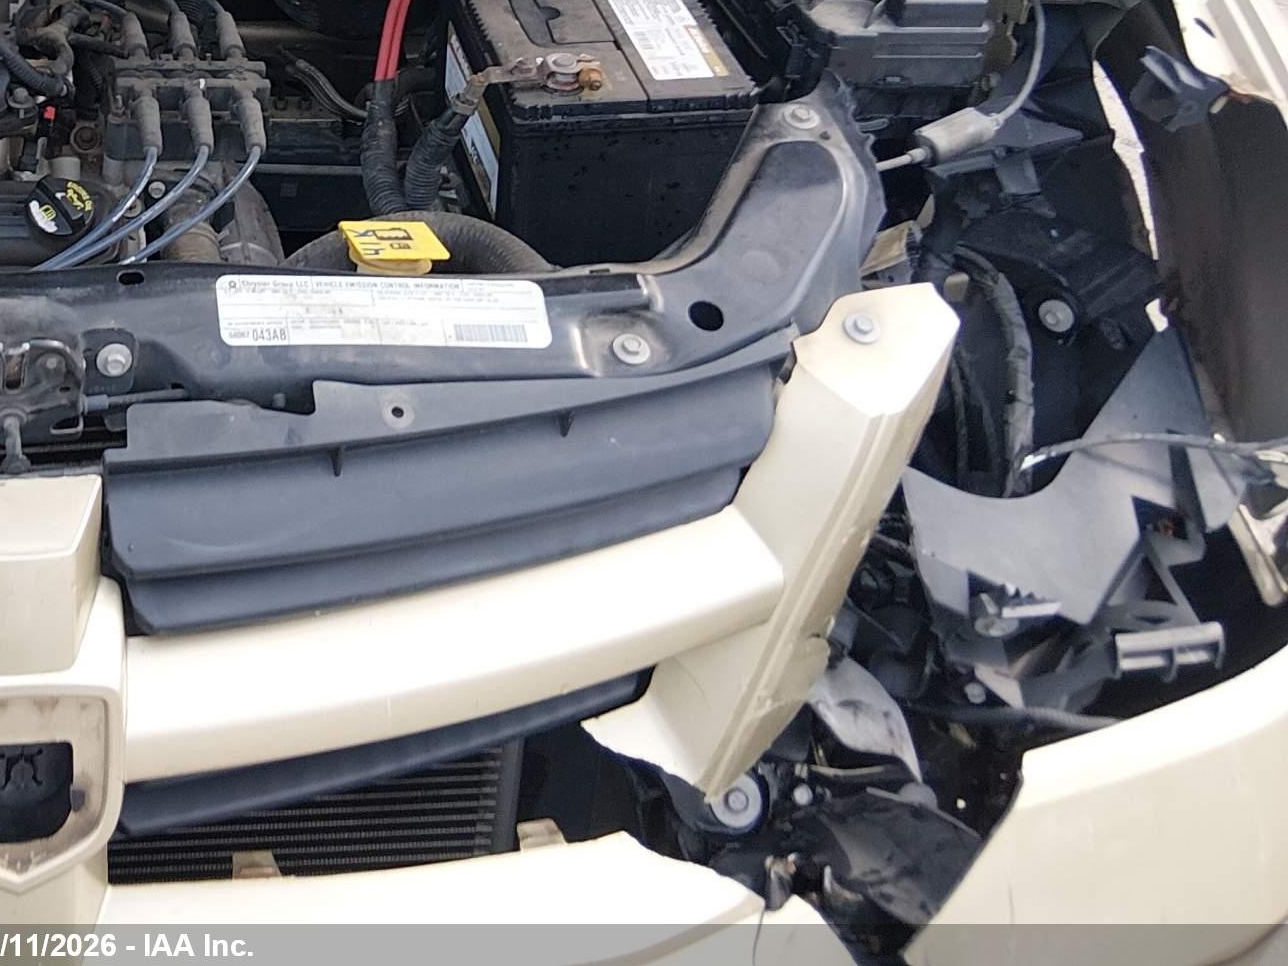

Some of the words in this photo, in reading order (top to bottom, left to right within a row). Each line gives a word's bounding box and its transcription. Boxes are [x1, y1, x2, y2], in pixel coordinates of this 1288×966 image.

[345, 281, 377, 290] EMISSION
[381, 281, 411, 290] CONTROL
[414, 282, 461, 291] INFORMATION
